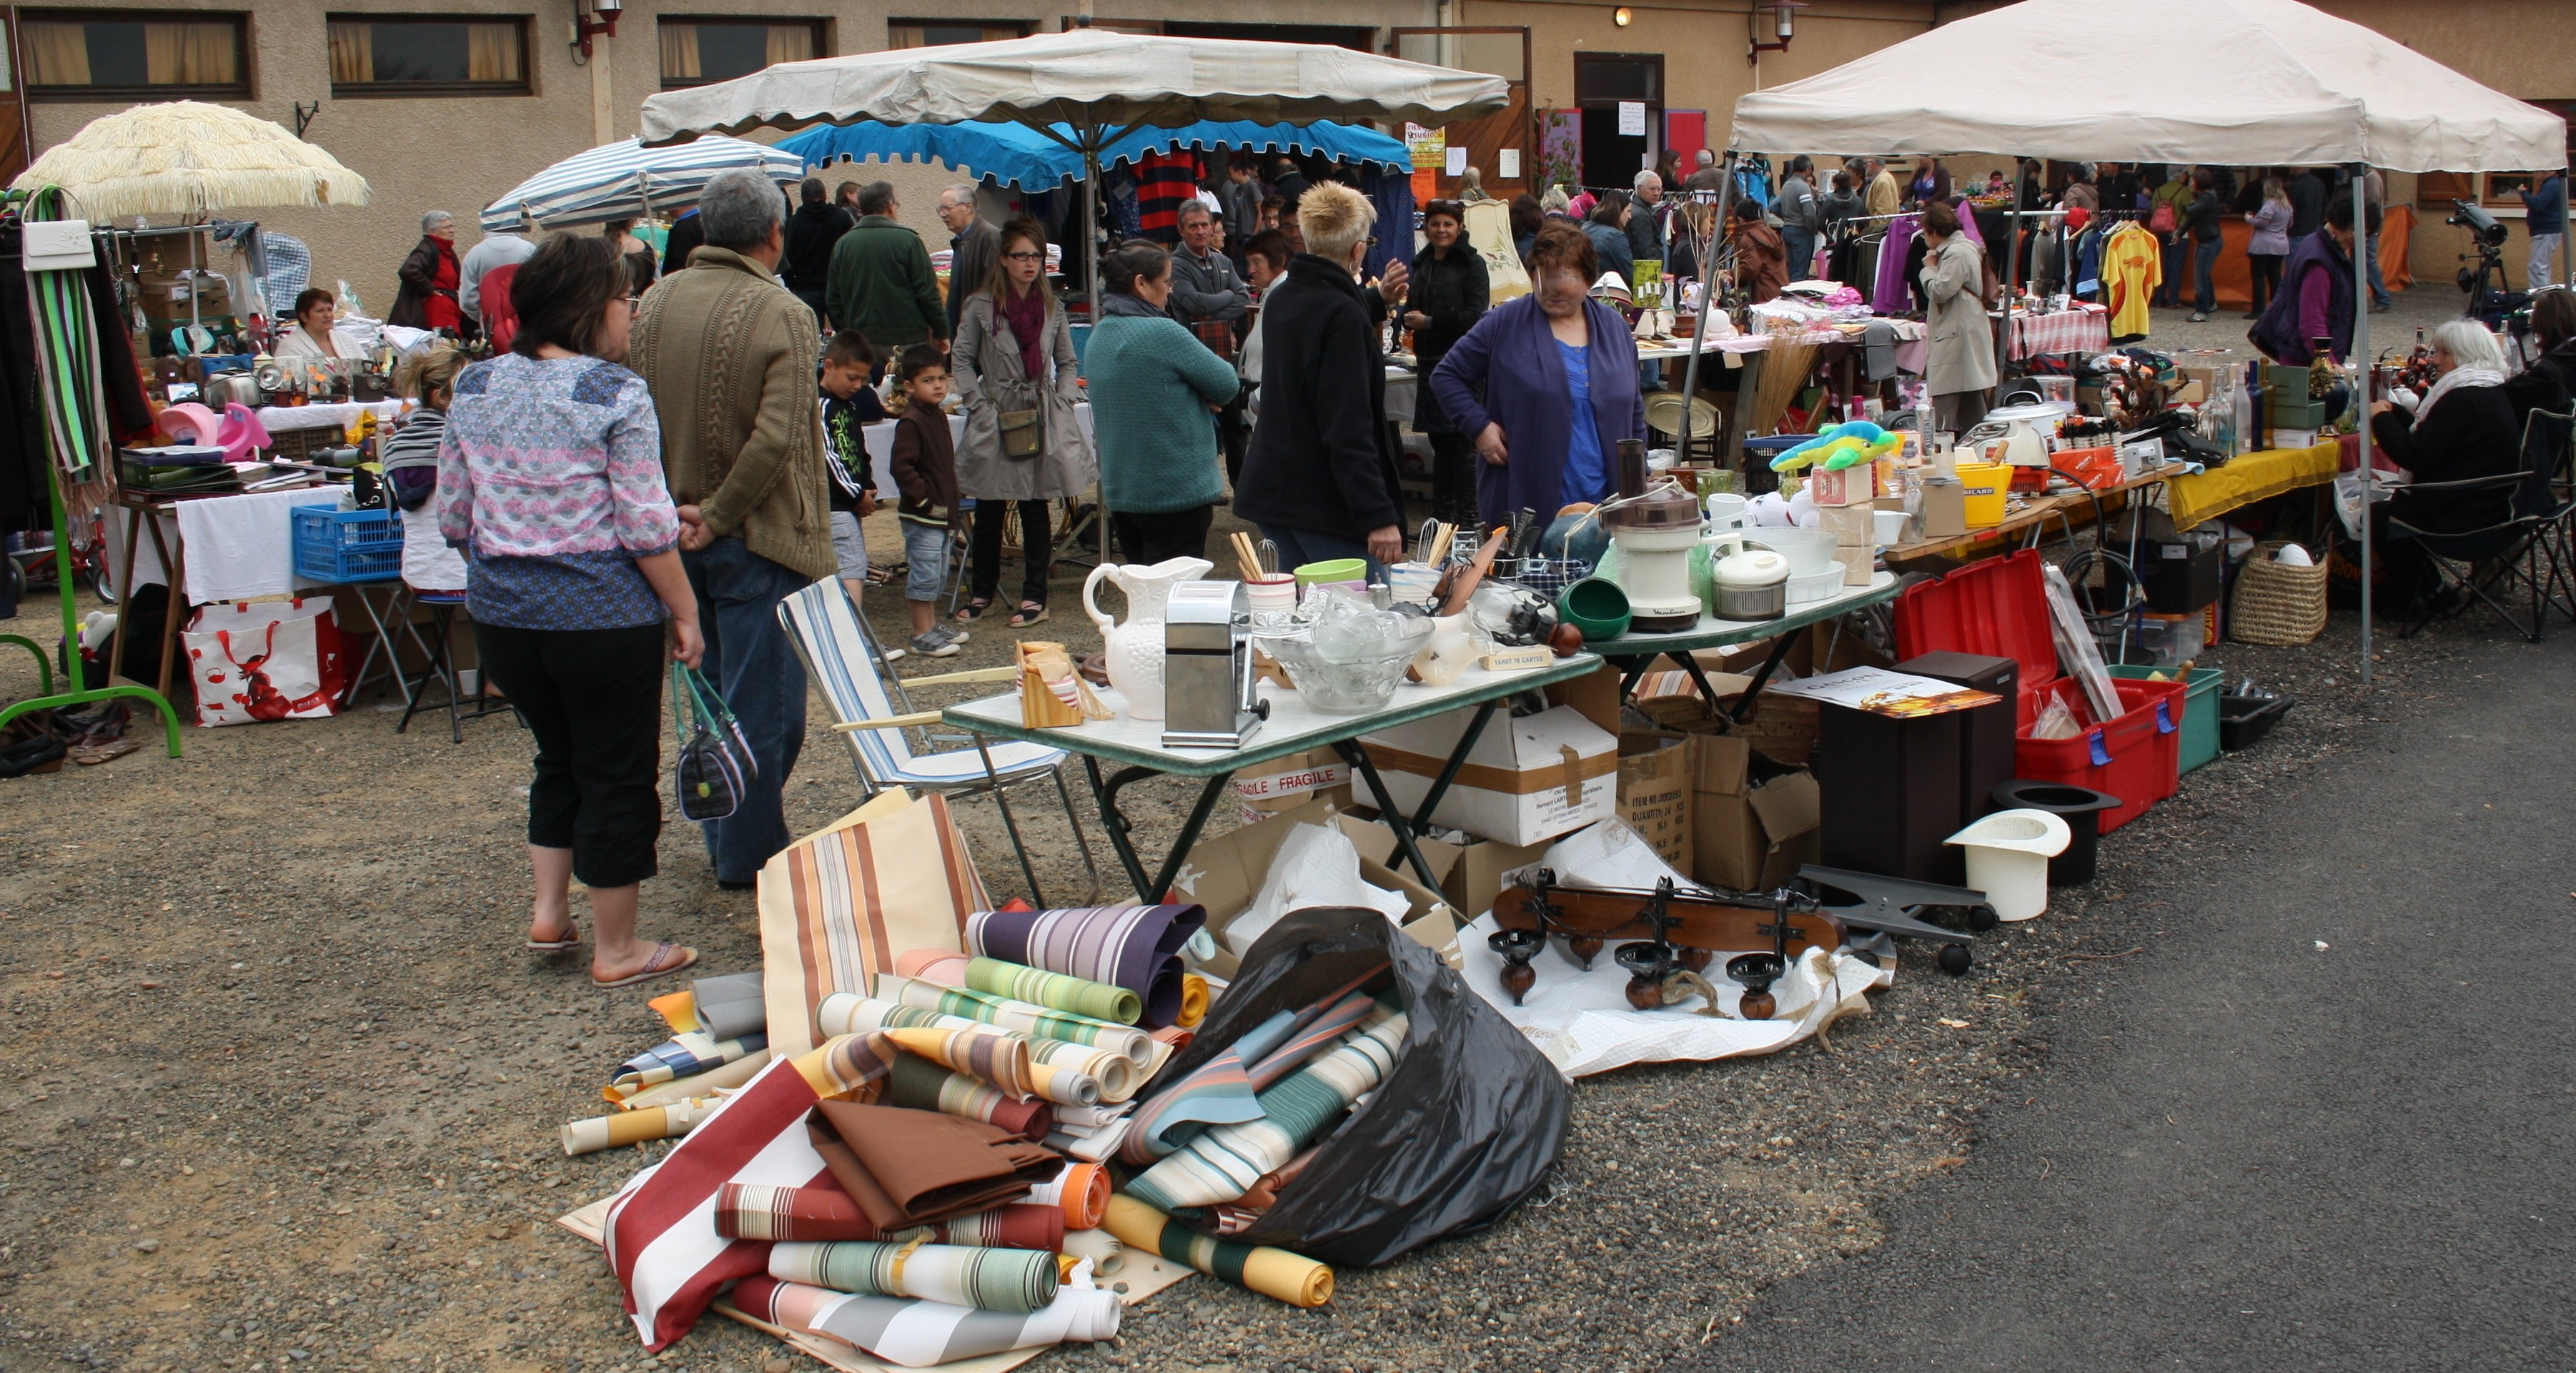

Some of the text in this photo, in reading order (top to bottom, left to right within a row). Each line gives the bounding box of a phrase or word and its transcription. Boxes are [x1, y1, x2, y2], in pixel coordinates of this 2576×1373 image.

[1239, 769, 1336, 795] RAGILE FRAGILE
[1633, 795, 1648, 807] ITEM
